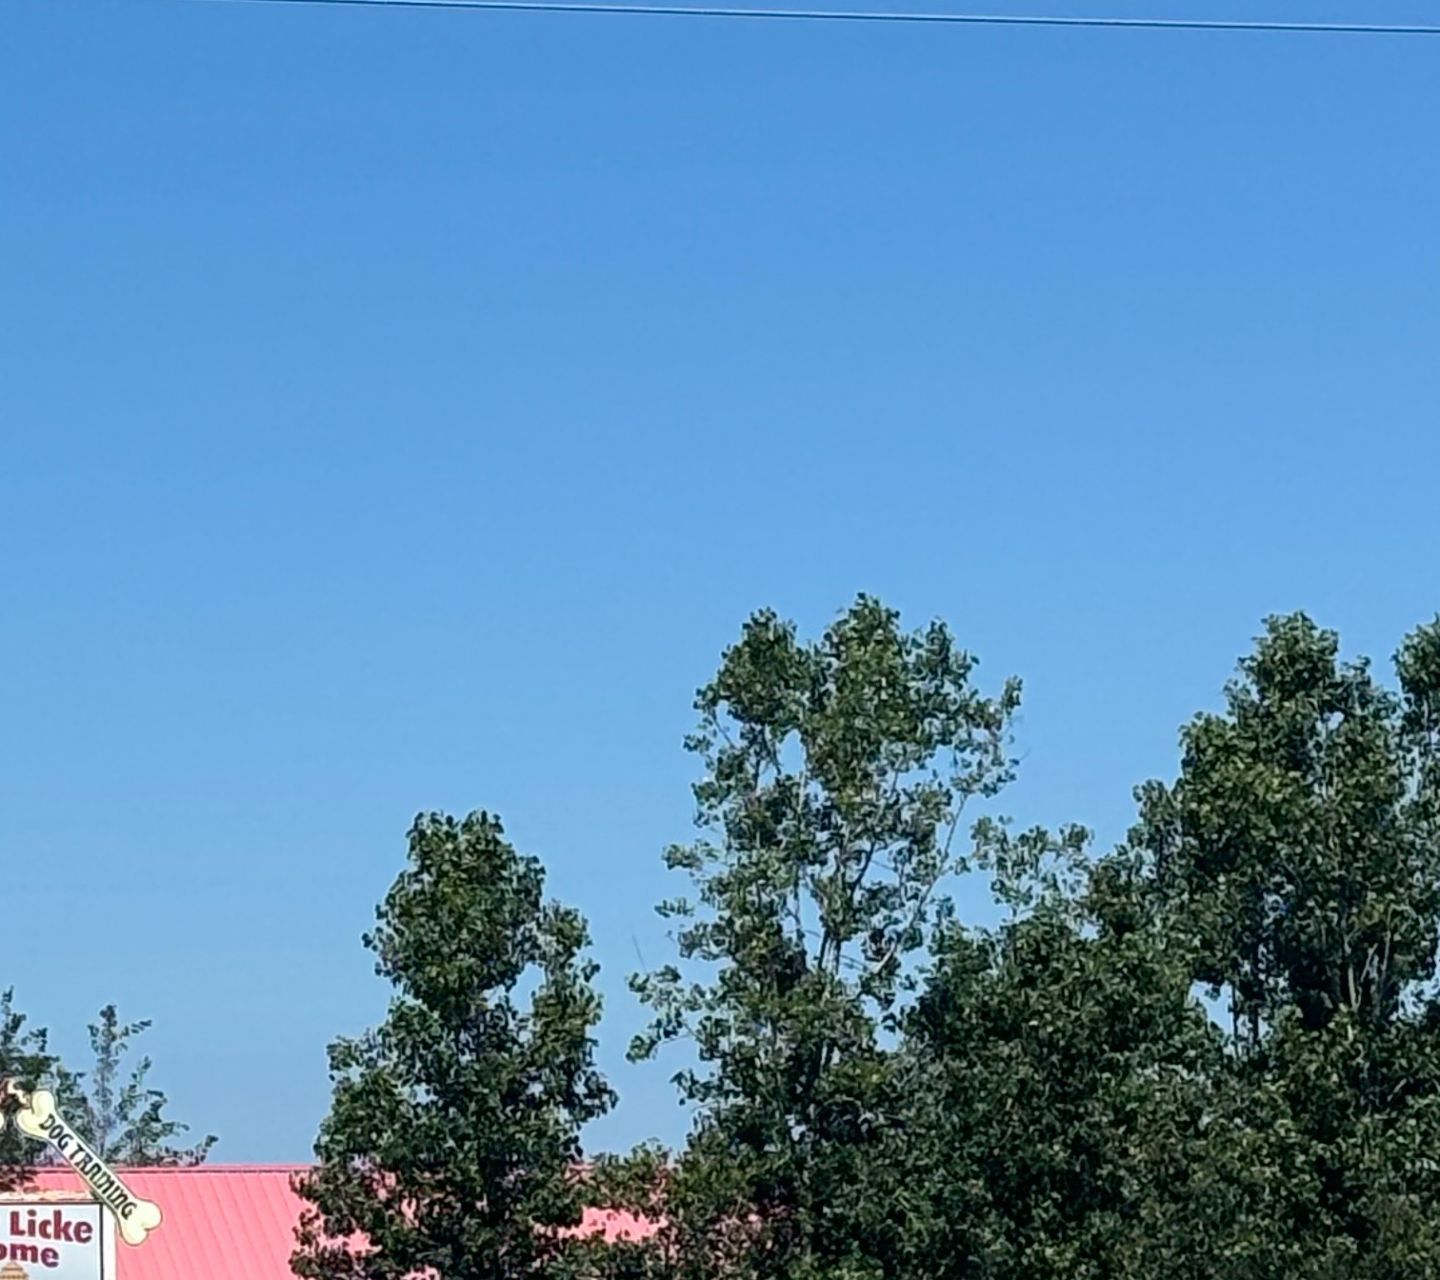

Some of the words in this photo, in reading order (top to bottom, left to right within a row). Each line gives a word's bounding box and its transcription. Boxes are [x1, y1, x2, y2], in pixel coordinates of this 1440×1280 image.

[38, 1113, 74, 1151] DOG
[68, 1143, 137, 1220] TRAINING
[10, 1209, 93, 1243] Licke
